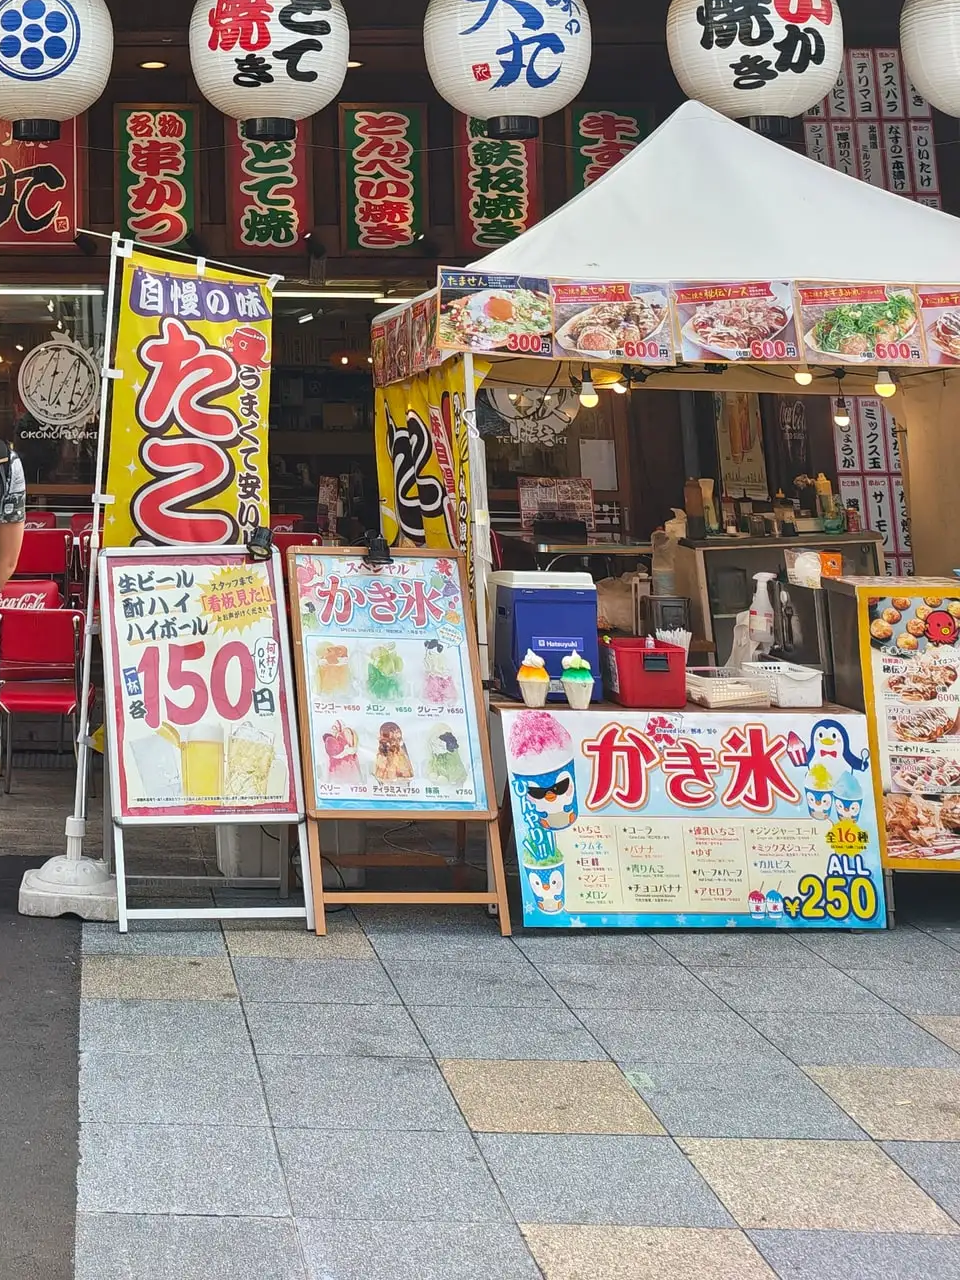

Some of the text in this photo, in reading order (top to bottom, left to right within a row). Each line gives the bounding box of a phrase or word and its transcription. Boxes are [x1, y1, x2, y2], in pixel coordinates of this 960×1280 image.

[856, 62, 873, 114] テリマヨ
[129, 113, 185, 138] 名物
[916, 135, 933, 187] しいたけ
[356, 112, 414, 248] とんぺい焼き
[130, 141, 186, 246] 串かつ
[243, 141, 296, 245] どて焼
[471, 140, 526, 245] 鉄板焼き
[137, 274, 267, 318] 自慢の味
[864, 408, 882, 470] ミックス玉
[117, 569, 194, 594] 生ビール
[210, 575, 254, 592] スタッフまで
[122, 591, 191, 618] 酎ハイ
[318, 575, 444, 627] かき氷
[126, 616, 208, 642] ハイボール
[546, 641, 578, 649] Hatsuyuki
[124, 670, 141, 695] 一杯
[128, 699, 147, 720] 各
[343, 704, 361, 712] ¥650
[446, 707, 465, 715] ¥650
[582, 723, 802, 813] かき氷
[403, 787, 421, 795] ¥750
[455, 788, 473, 796] ¥750
[577, 825, 601, 834] いちご
[628, 825, 653, 835] コーラ
[754, 826, 818, 836] ジンジャーエール
[581, 841, 603, 851] ラムネ
[629, 844, 655, 854] バナナ
[695, 848, 713, 857] ゆず
[757, 843, 816, 852] ミックスジュース
[631, 863, 665, 874] 青りんご
[827, 854, 872, 876] ALL
[583, 874, 615, 883] マンゴー
[633, 883, 683, 893] チョコバナナ
[585, 890, 609, 900] メロン
[699, 887, 733, 897] アセロラ
[783, 875, 878, 919] ¥250
